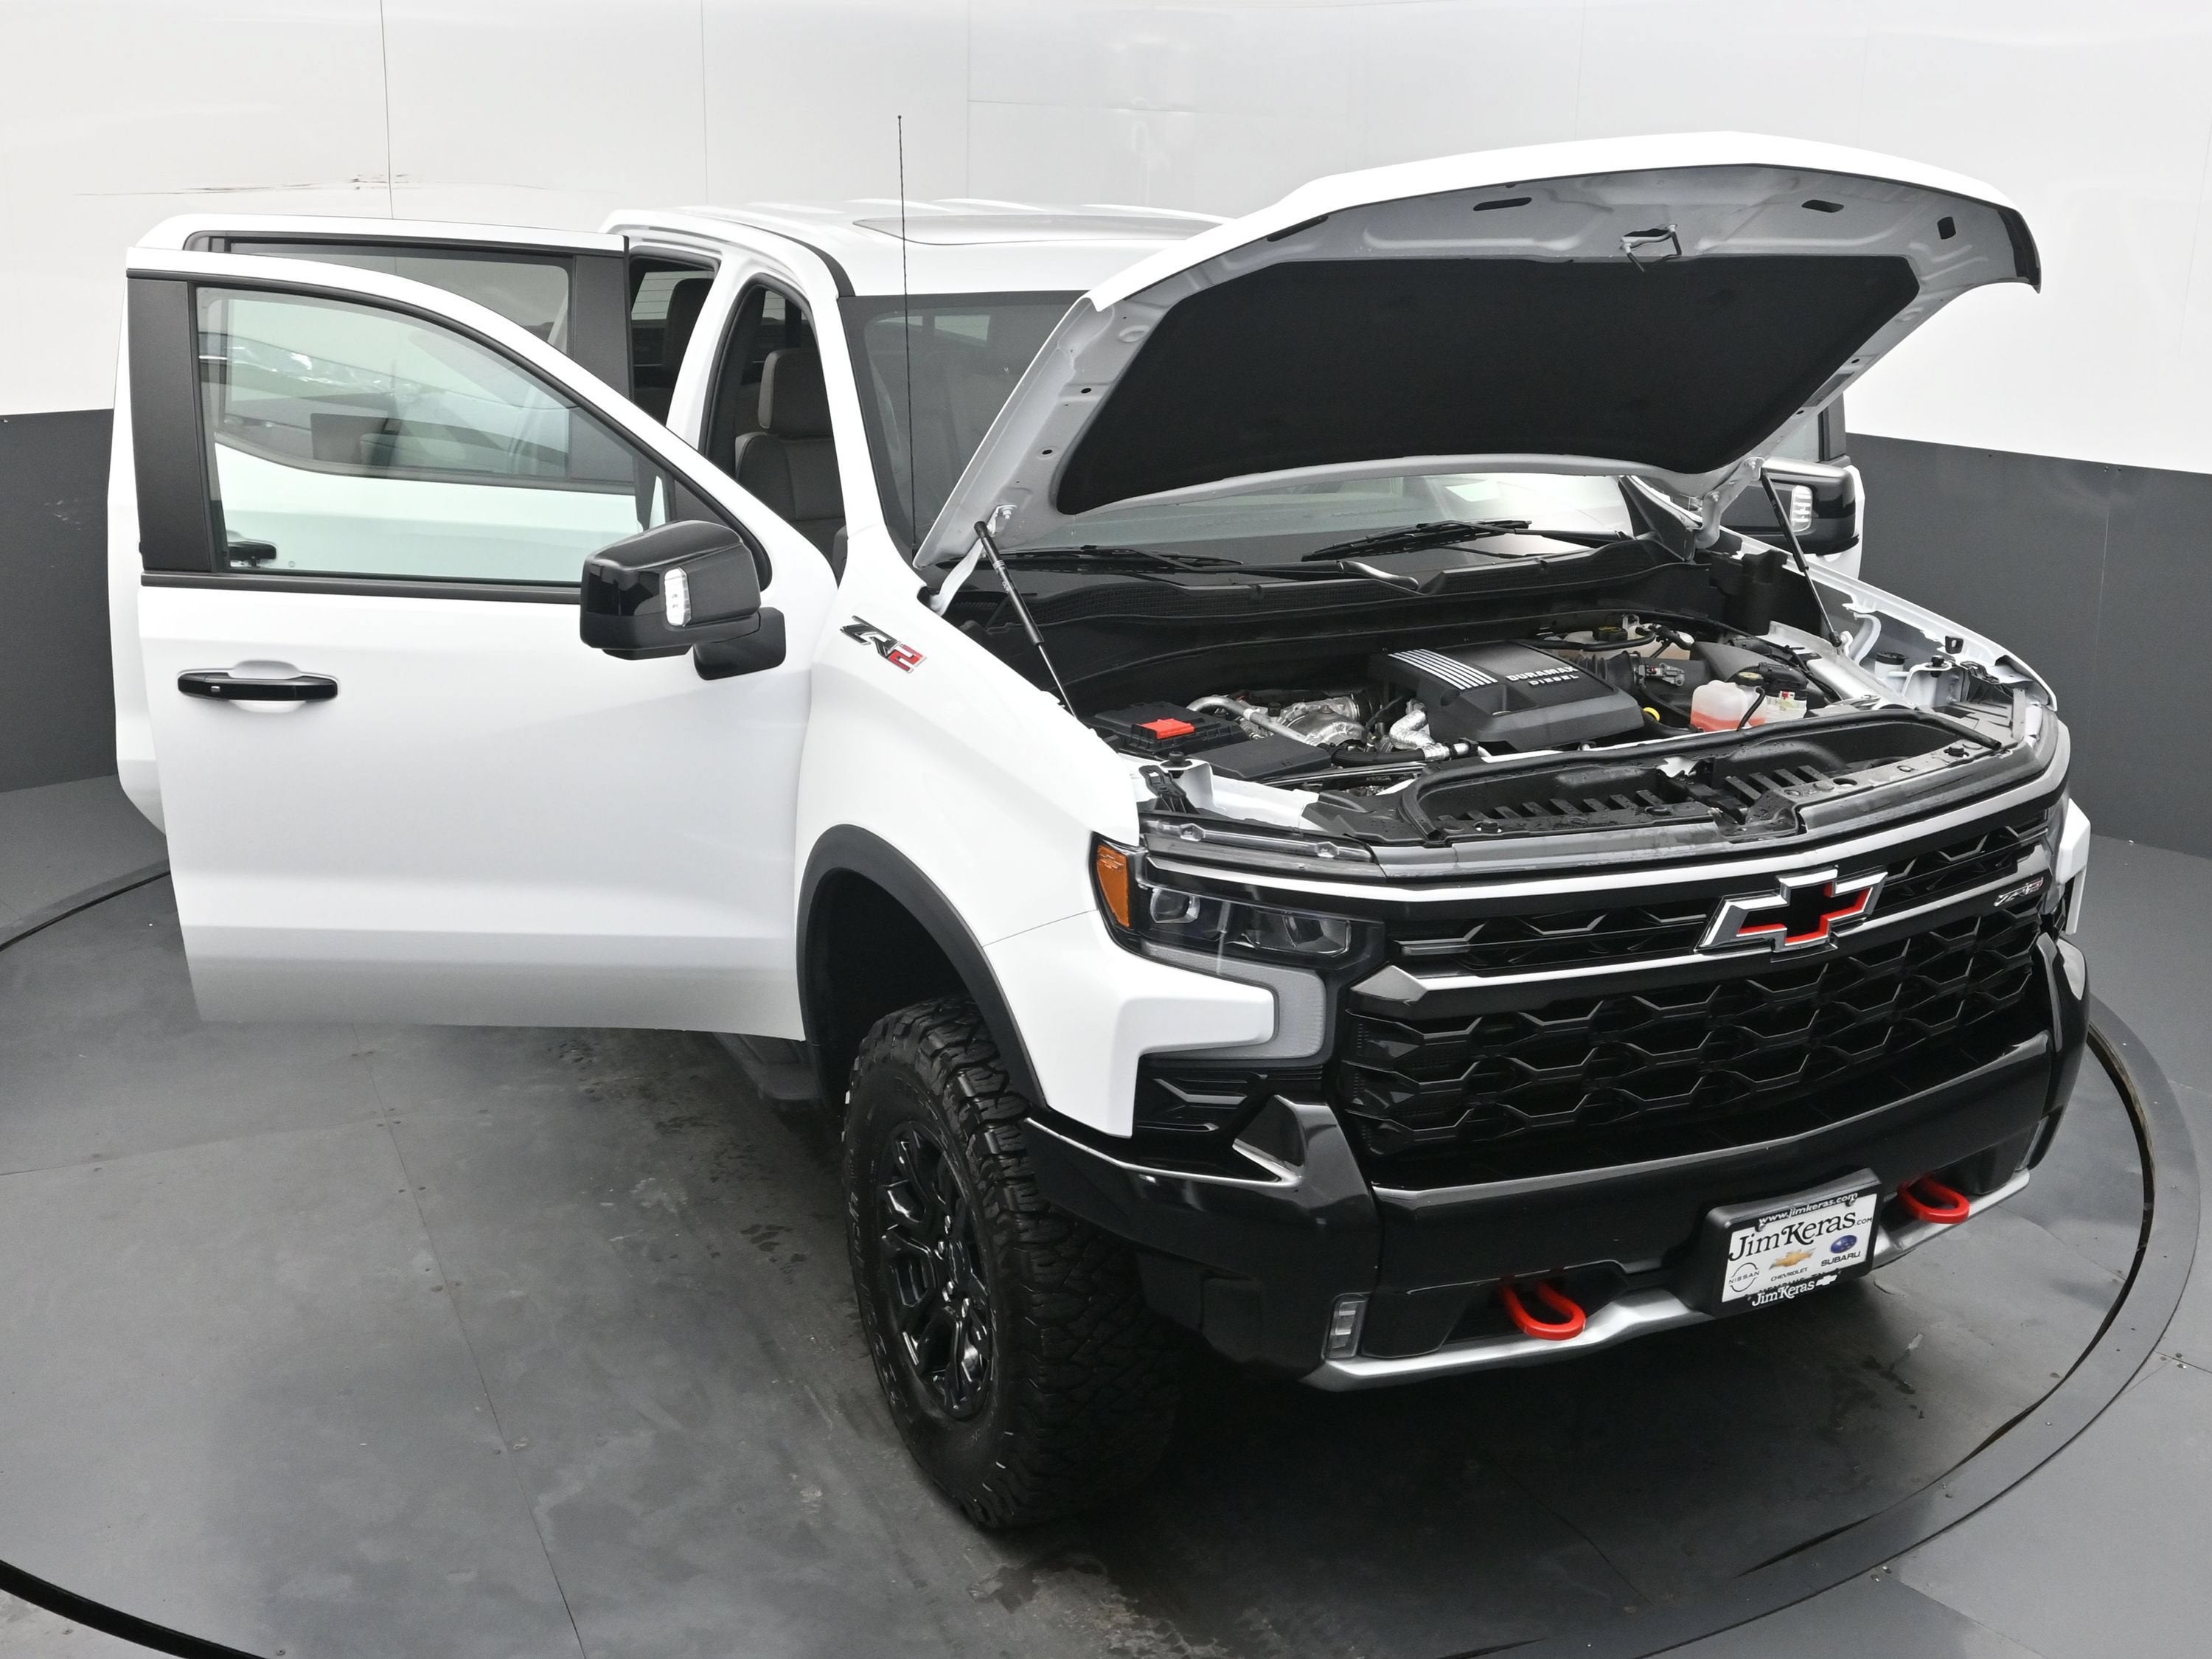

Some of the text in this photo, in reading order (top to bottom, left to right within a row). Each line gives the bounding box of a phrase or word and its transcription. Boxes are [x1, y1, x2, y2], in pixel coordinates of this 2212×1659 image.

[840, 615, 927, 673] ZR2
[1506, 666, 1579, 681] DURAMAX
[1528, 675, 1579, 686] DIESEL
[1759, 1192, 1858, 1225] www.jimkeras.com
[1820, 1251, 1861, 1267] SUBARU
[1728, 1270, 1760, 1284] NISSAN
[1770, 1267, 1808, 1281] CHEVROLET
